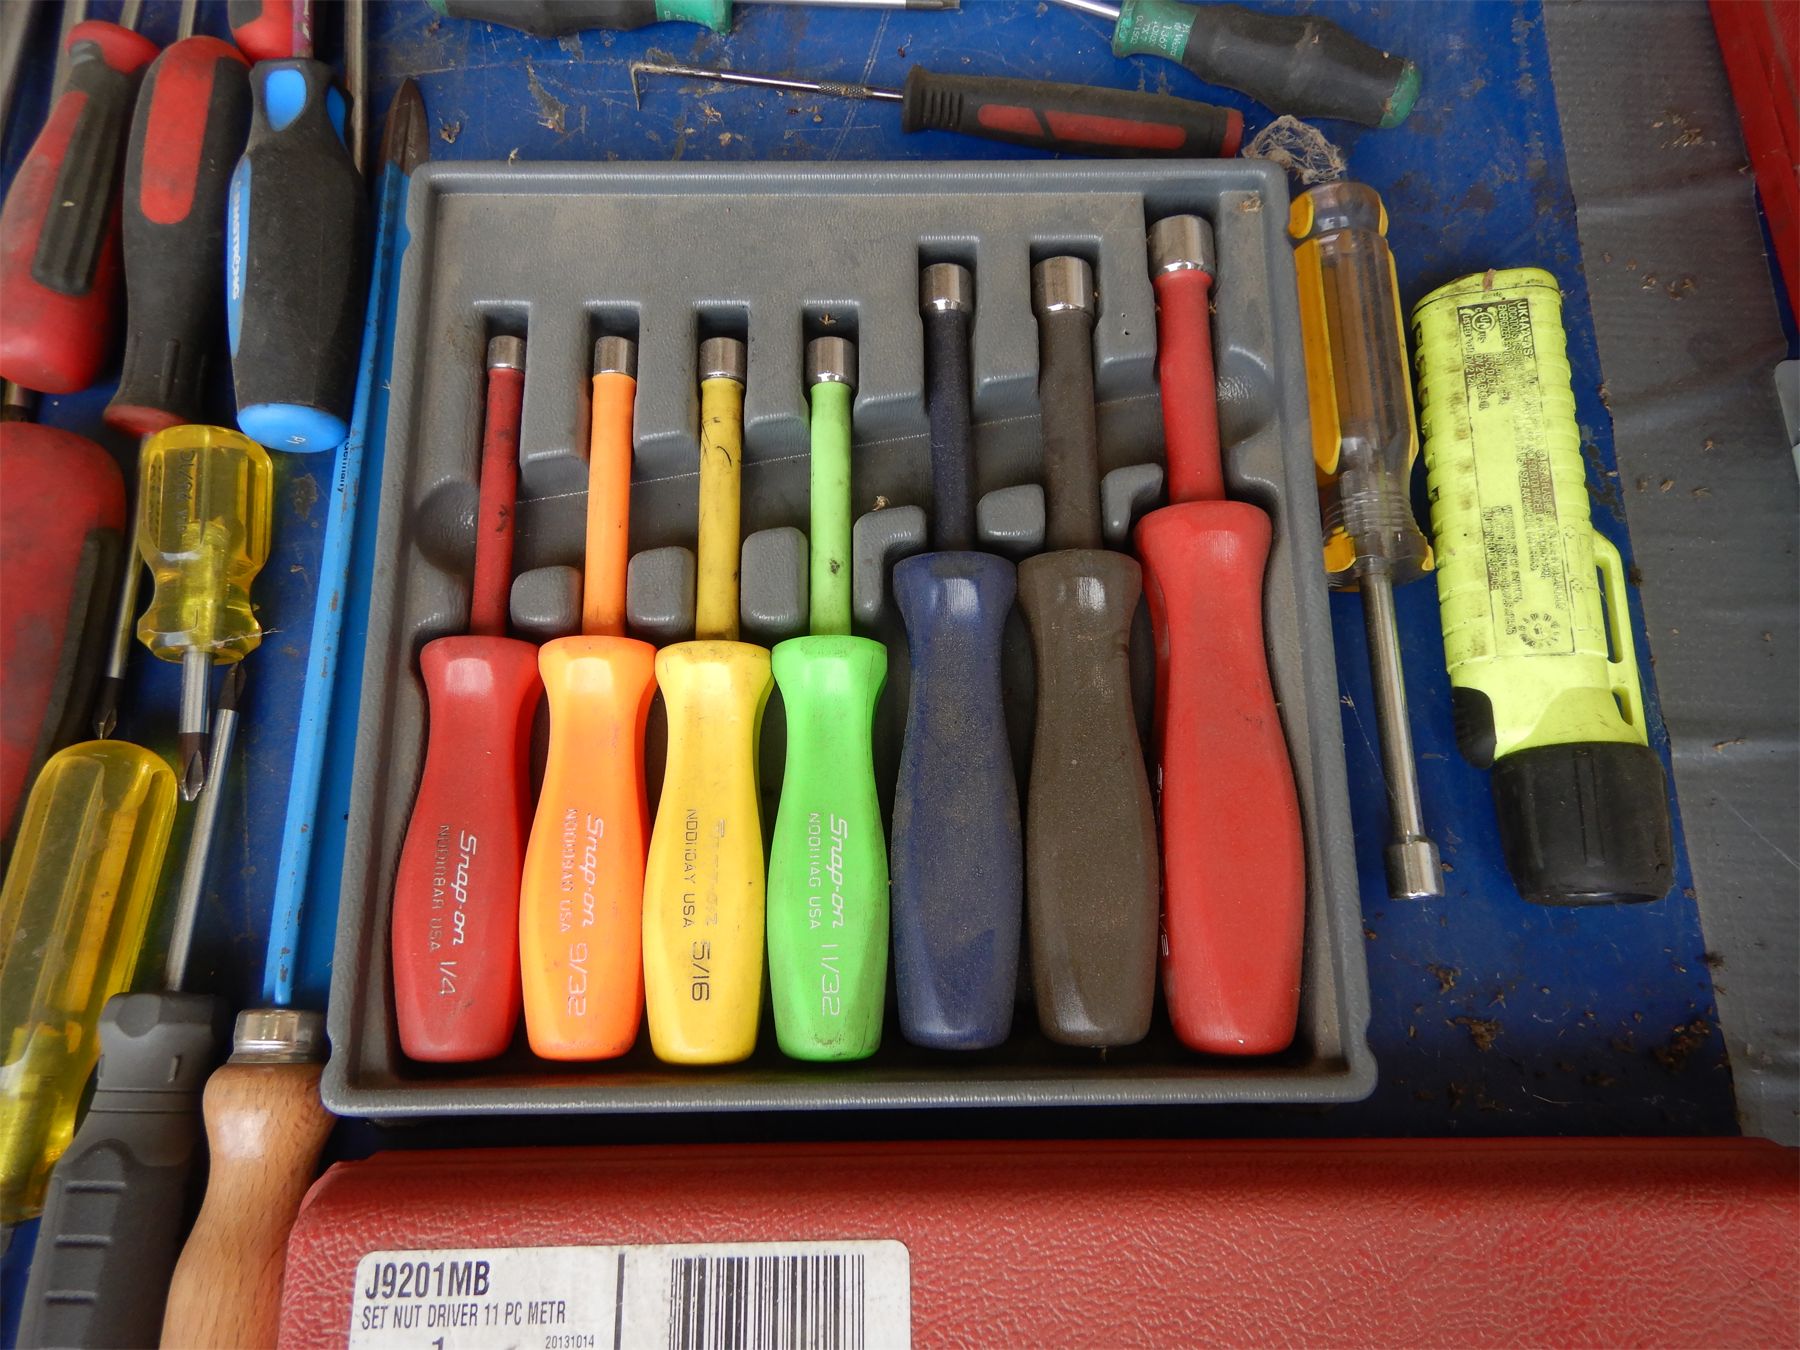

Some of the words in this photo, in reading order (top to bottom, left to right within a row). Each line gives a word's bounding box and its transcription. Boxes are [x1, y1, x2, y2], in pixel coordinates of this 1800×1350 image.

[451, 830, 477, 946] Snap-on
[578, 813, 604, 928] Snap-on
[826, 813, 848, 929] Snap-on
[559, 899, 574, 933] USA
[682, 893, 696, 929] USA
[808, 896, 822, 930] USA
[428, 918, 442, 953] USA
[439, 961, 457, 996] 1/4
[567, 943, 588, 1017] 9/32
[691, 941, 711, 1002] 5/16
[820, 944, 841, 1017] 11/32
[365, 1260, 491, 1300] J9201MB
[362, 1305, 389, 1330] SET
[393, 1304, 423, 1328] NUT
[427, 1303, 479, 1328] DRIVER
[484, 1302, 500, 1326] 11
[504, 1301, 523, 1326] PC
[527, 1300, 567, 1325] METR
[545, 1334, 595, 1350] 20131014
